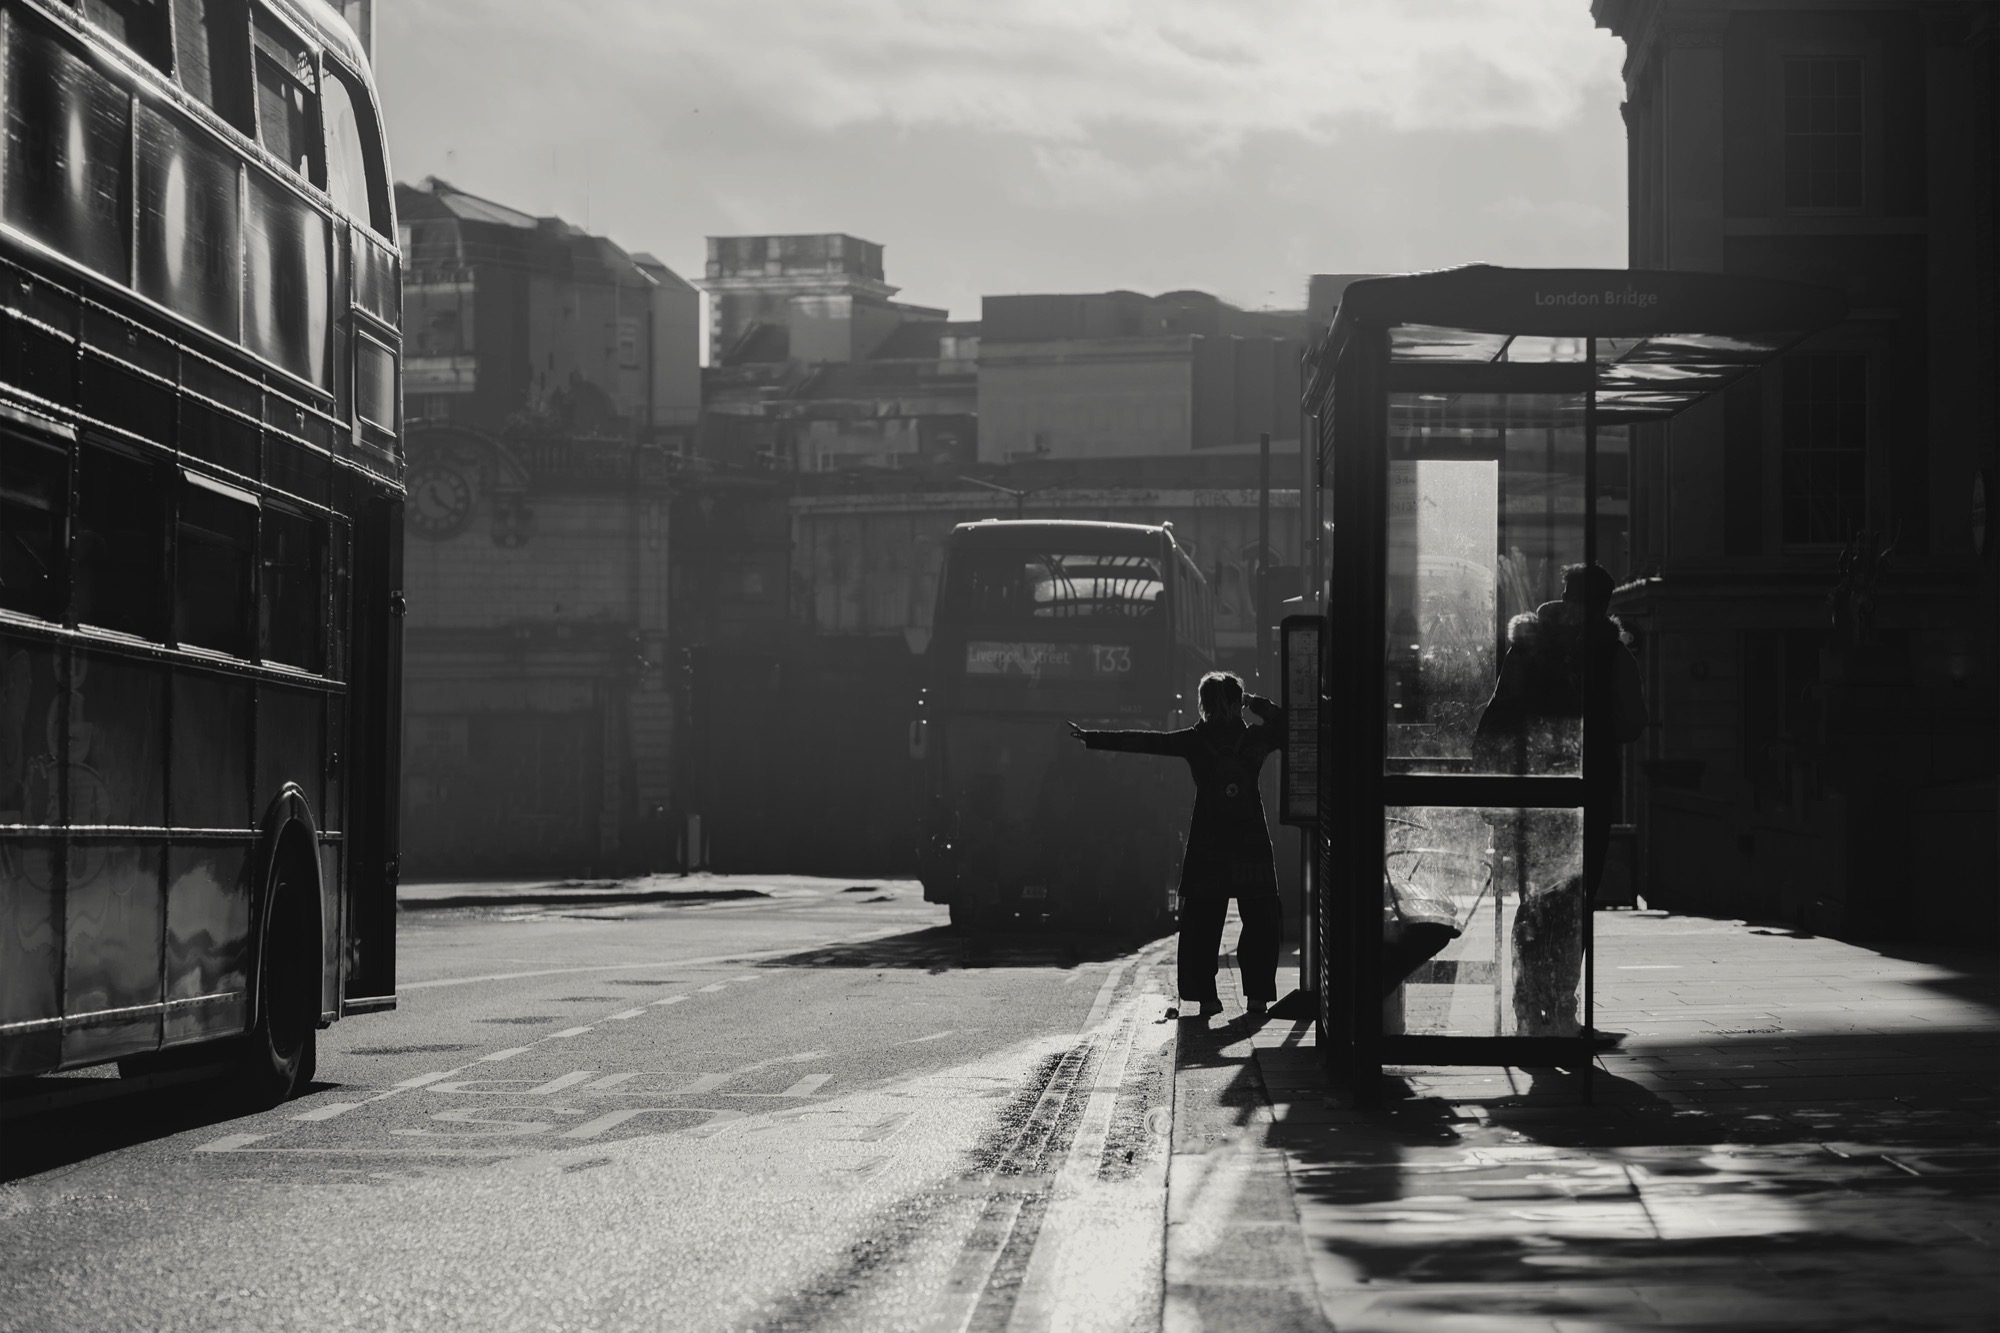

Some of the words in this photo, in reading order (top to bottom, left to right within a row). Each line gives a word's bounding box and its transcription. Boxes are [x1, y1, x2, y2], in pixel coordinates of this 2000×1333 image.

[1535, 291, 1599, 306] London
[1604, 290, 1658, 308] Bridge
[1030, 646, 1071, 665] Street
[1094, 645, 1132, 673] 133
